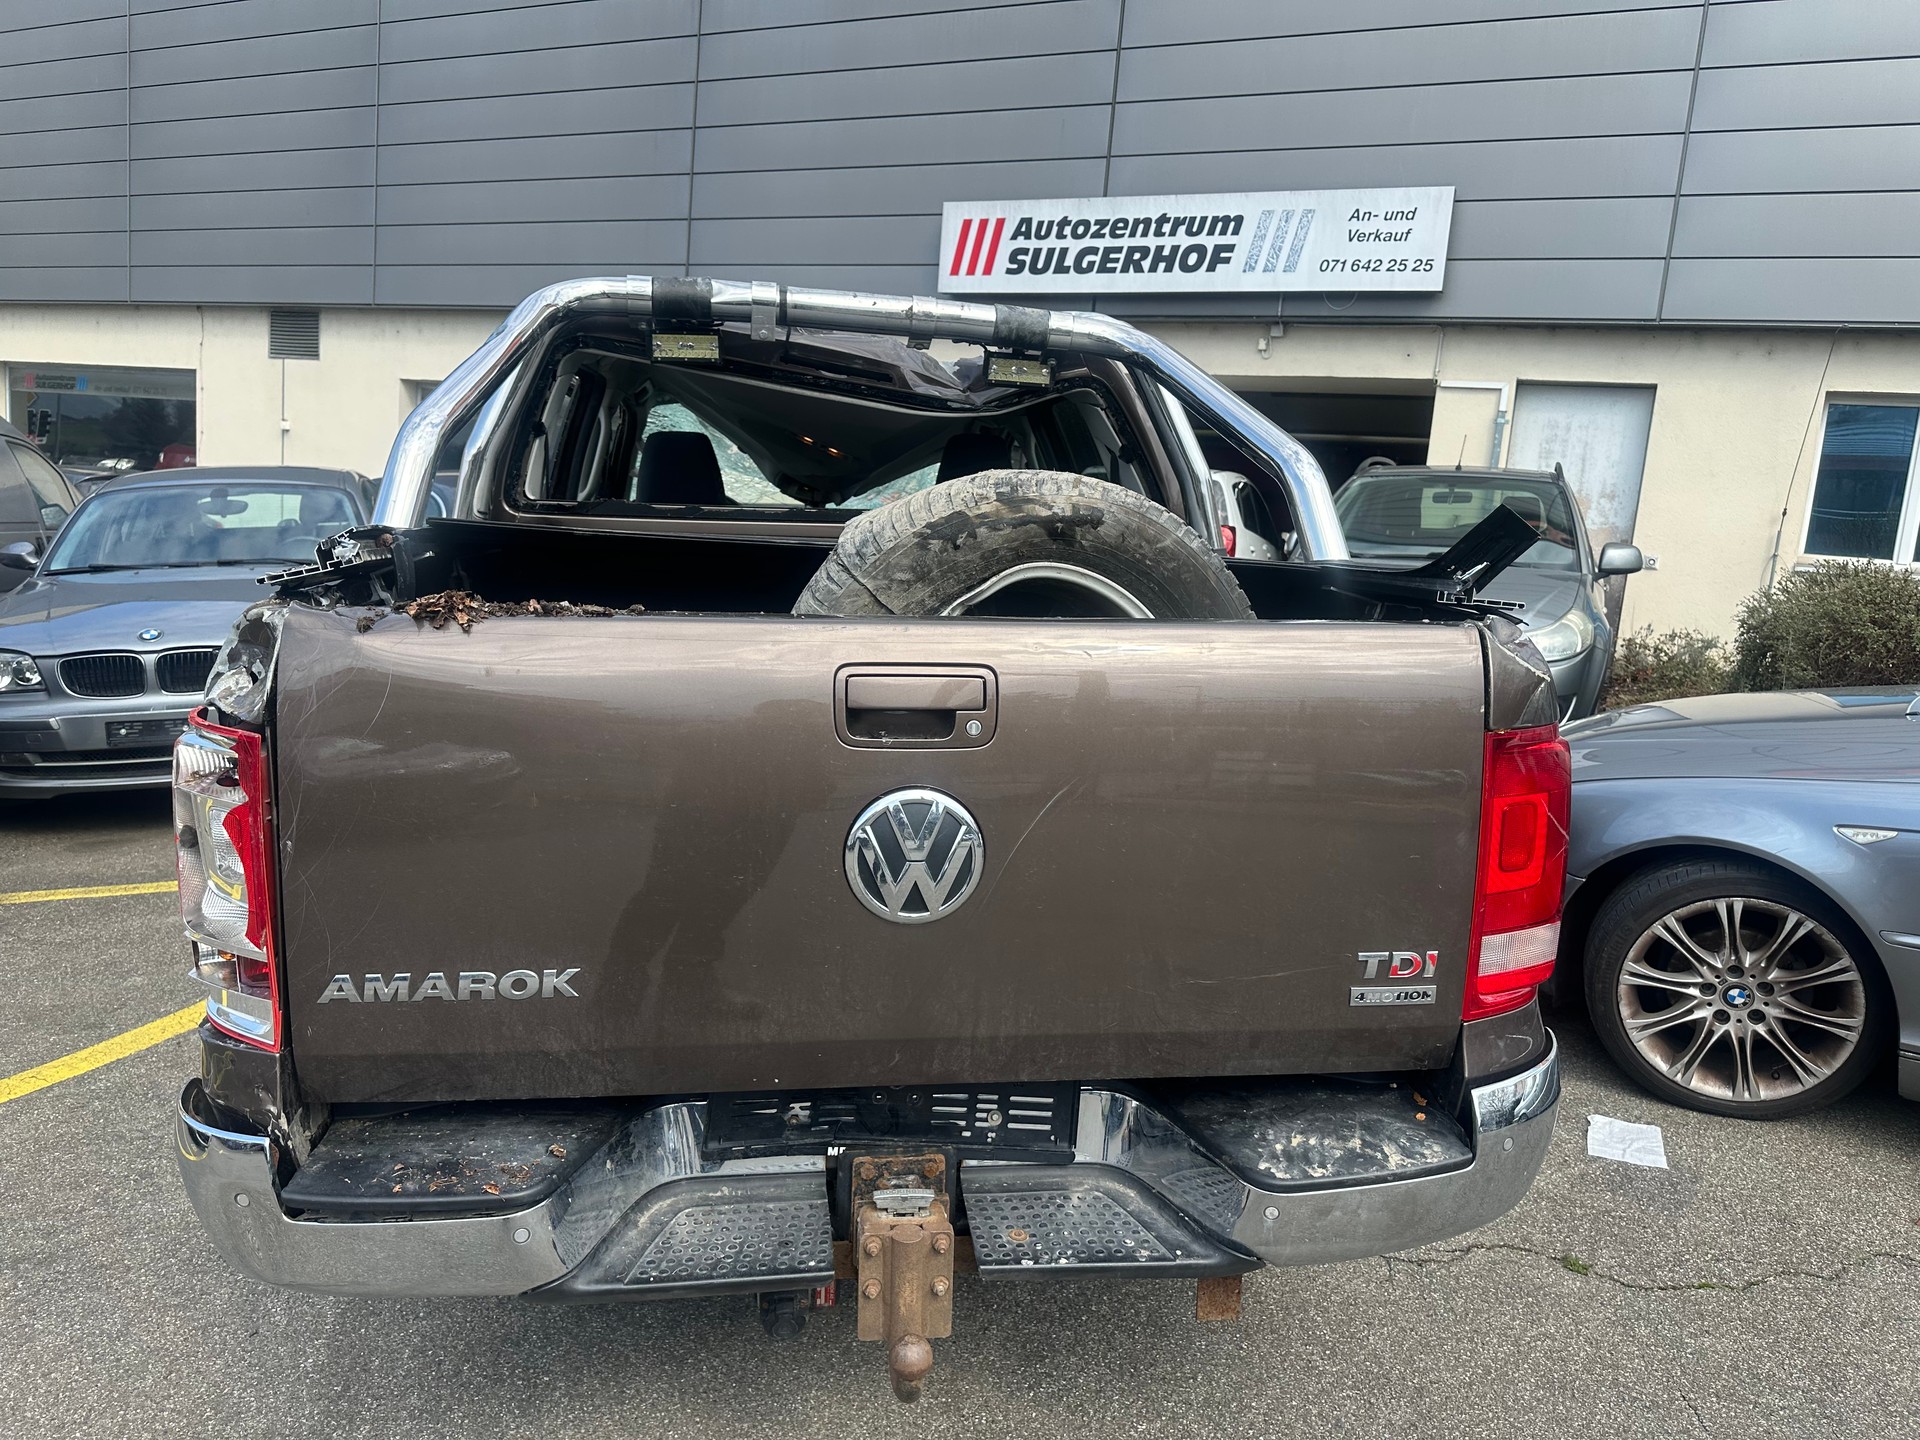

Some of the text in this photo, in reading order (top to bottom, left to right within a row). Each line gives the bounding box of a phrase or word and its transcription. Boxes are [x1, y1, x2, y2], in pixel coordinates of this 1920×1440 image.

[1009, 212, 1244, 241] Autozentrum
[1348, 207, 1417, 222] An- und
[1348, 228, 1413, 243] Verkauf
[1005, 243, 1236, 276] SULGERHOF
[1319, 259, 1434, 273] 071 642 25 25
[1358, 950, 1439, 979] TDI
[316, 967, 582, 1004] AMAROK
